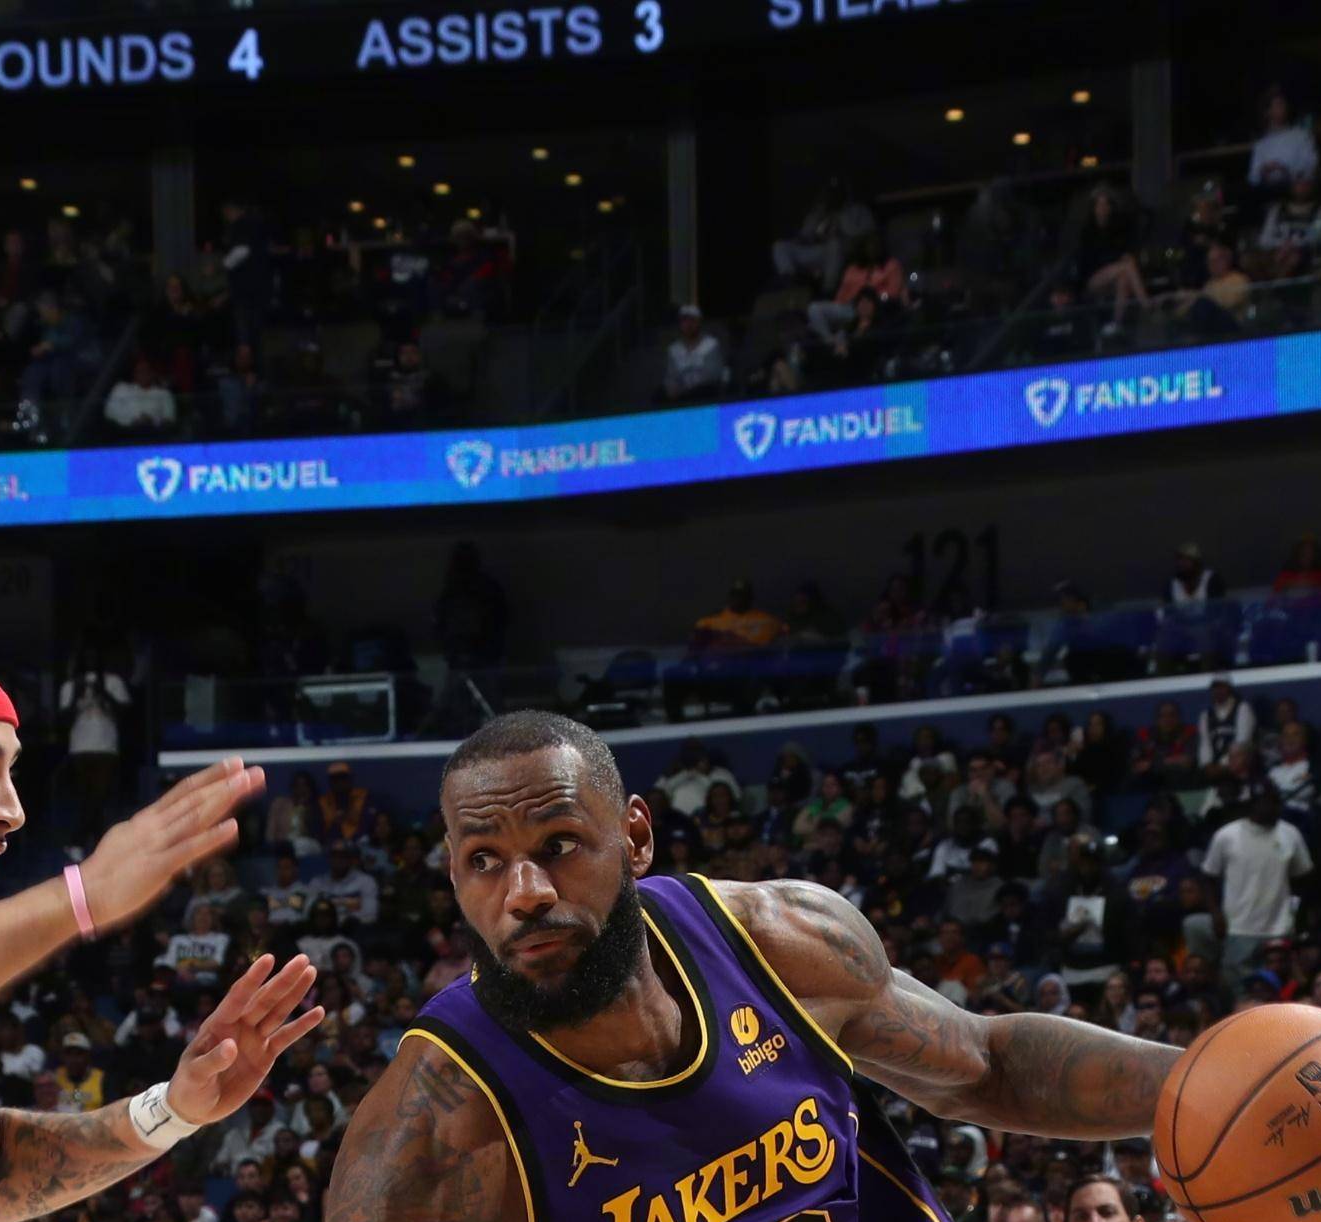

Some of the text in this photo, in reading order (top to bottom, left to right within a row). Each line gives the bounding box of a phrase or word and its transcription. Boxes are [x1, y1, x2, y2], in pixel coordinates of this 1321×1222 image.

[228, 28, 264, 79] 4
[357, 0, 664, 68] ASSISTS 3
[1076, 368, 1223, 412] FANDUEL
[782, 406, 922, 445] FANDUEL
[187, 458, 339, 494] FANDUEL
[499, 438, 636, 478] FANDUEL
[902, 522, 999, 614] 121
[738, 1033, 787, 1076] bibigo
